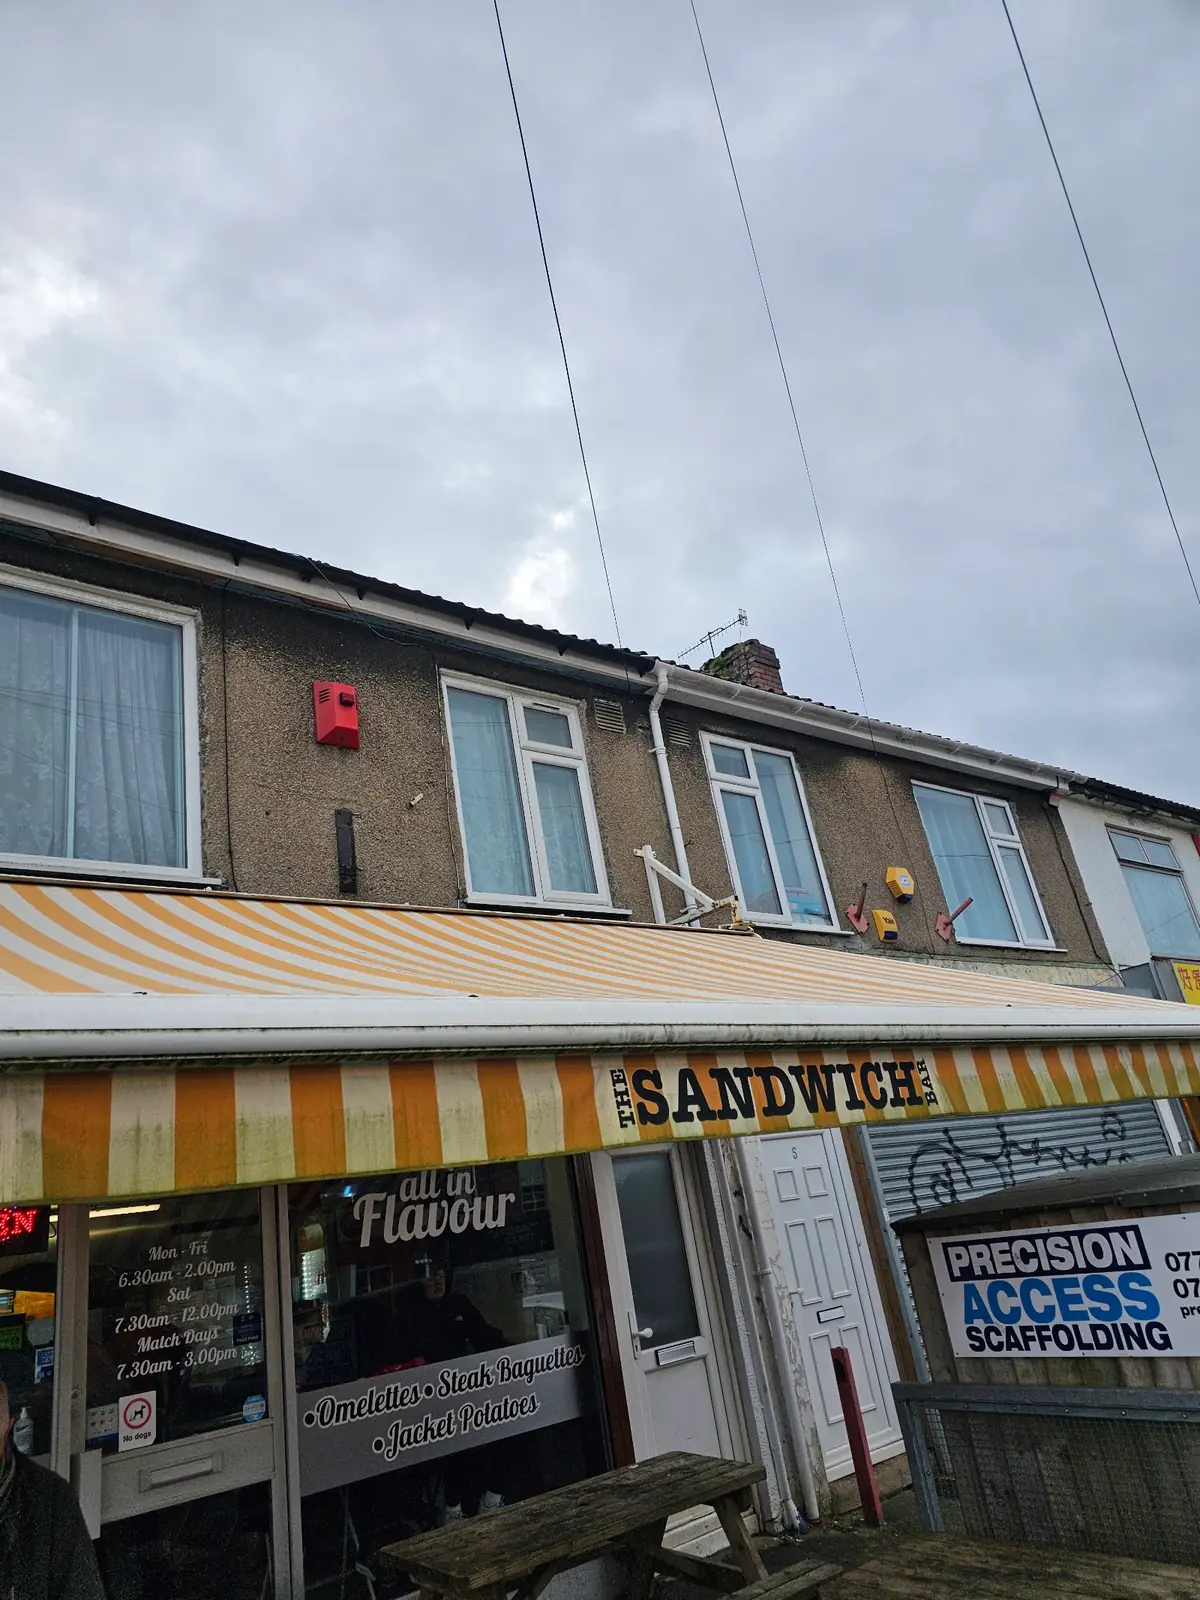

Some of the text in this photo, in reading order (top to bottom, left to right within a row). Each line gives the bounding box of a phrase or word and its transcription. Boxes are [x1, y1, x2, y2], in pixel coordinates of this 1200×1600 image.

[610, 1058, 939, 1129] THE SANDWICH BAR
[400, 1167, 477, 1202] all in
[353, 1192, 516, 1248] Flavour
[148, 1246, 179, 1261] Mon
[189, 1241, 208, 1256] Fri
[947, 1230, 1144, 1278] PRECISION
[118, 1269, 173, 1288] 6.30am
[184, 1260, 236, 1278] 2.00pm
[1173, 1277, 1200, 1299] 07
[167, 1287, 192, 1303] Sat
[963, 1272, 1160, 1325] ACCESS
[114, 1314, 171, 1334] 7.30am
[181, 1302, 240, 1323] 12.00pm
[137, 1332, 181, 1354] Match
[183, 1327, 219, 1345] Days
[965, 1321, 1173, 1352] SCAFFOLDING
[116, 1359, 173, 1380] 7.30am
[184, 1347, 238, 1367] 3.00pm
[317, 1345, 585, 1428] Omelettes Steak Baguettes
[123, 1431, 152, 1443] No dogs
[386, 1393, 541, 1459] Jacket Potatoes
